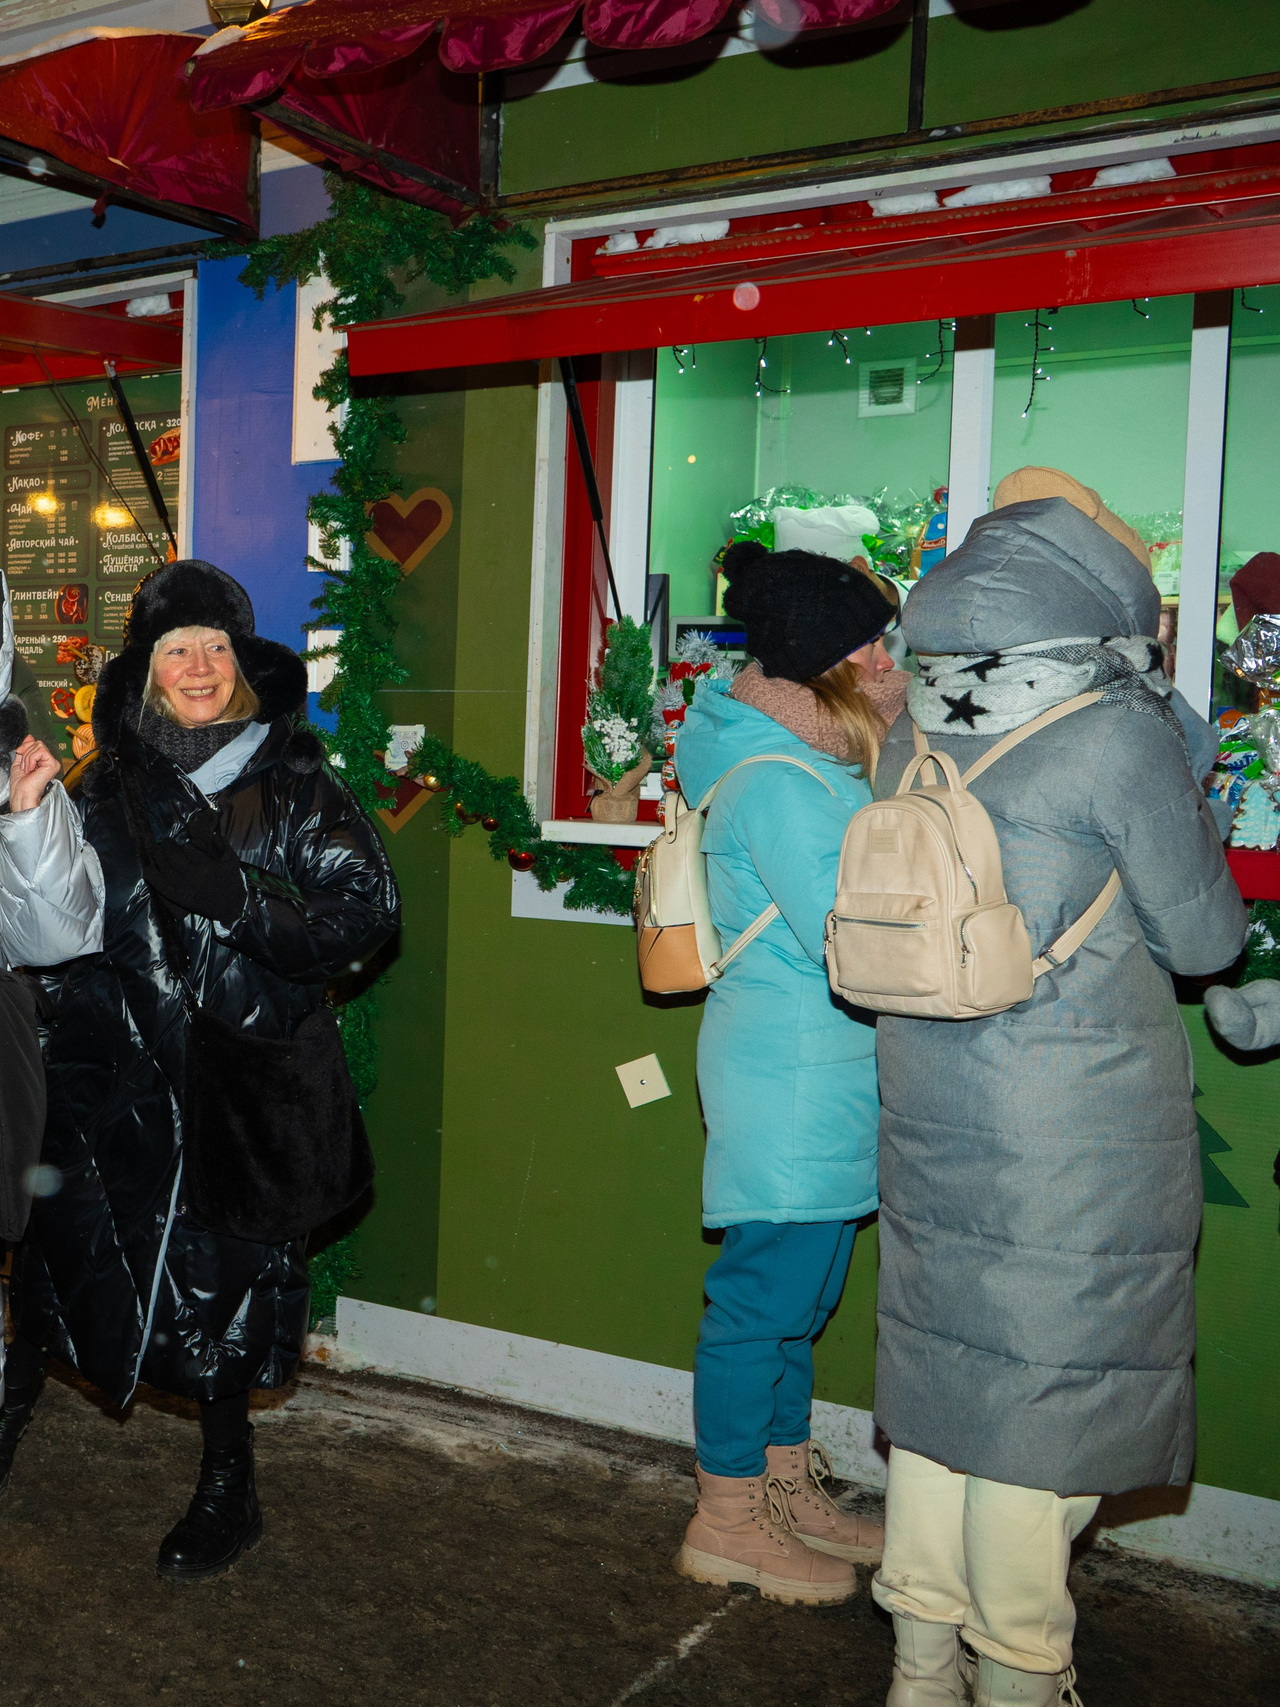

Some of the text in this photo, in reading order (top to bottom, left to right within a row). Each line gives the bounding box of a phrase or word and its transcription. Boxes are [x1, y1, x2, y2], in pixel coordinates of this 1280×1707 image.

[86, 396, 118, 412] МЕН
[106, 420, 157, 437] КОЛАСКА
[12, 430, 40, 446] КОФЕ
[157, 471, 163, 480] 2
[9, 477, 41, 492] КАКАО
[8, 535, 75, 552] АВТОРСКИЙ ЧАЙ
[103, 554, 144, 567] ТУШЁНАЯ
[103, 564, 138, 574] КАПУСТА
[9, 588, 59, 603] ГЛИНТВЕЙН
[104, 591, 133, 604] СЕНДВ
[52, 635, 67, 643] 250
[15, 646, 43, 655] НДАЛЬ
[36, 679, 67, 689] ВЕНСКИЙ
